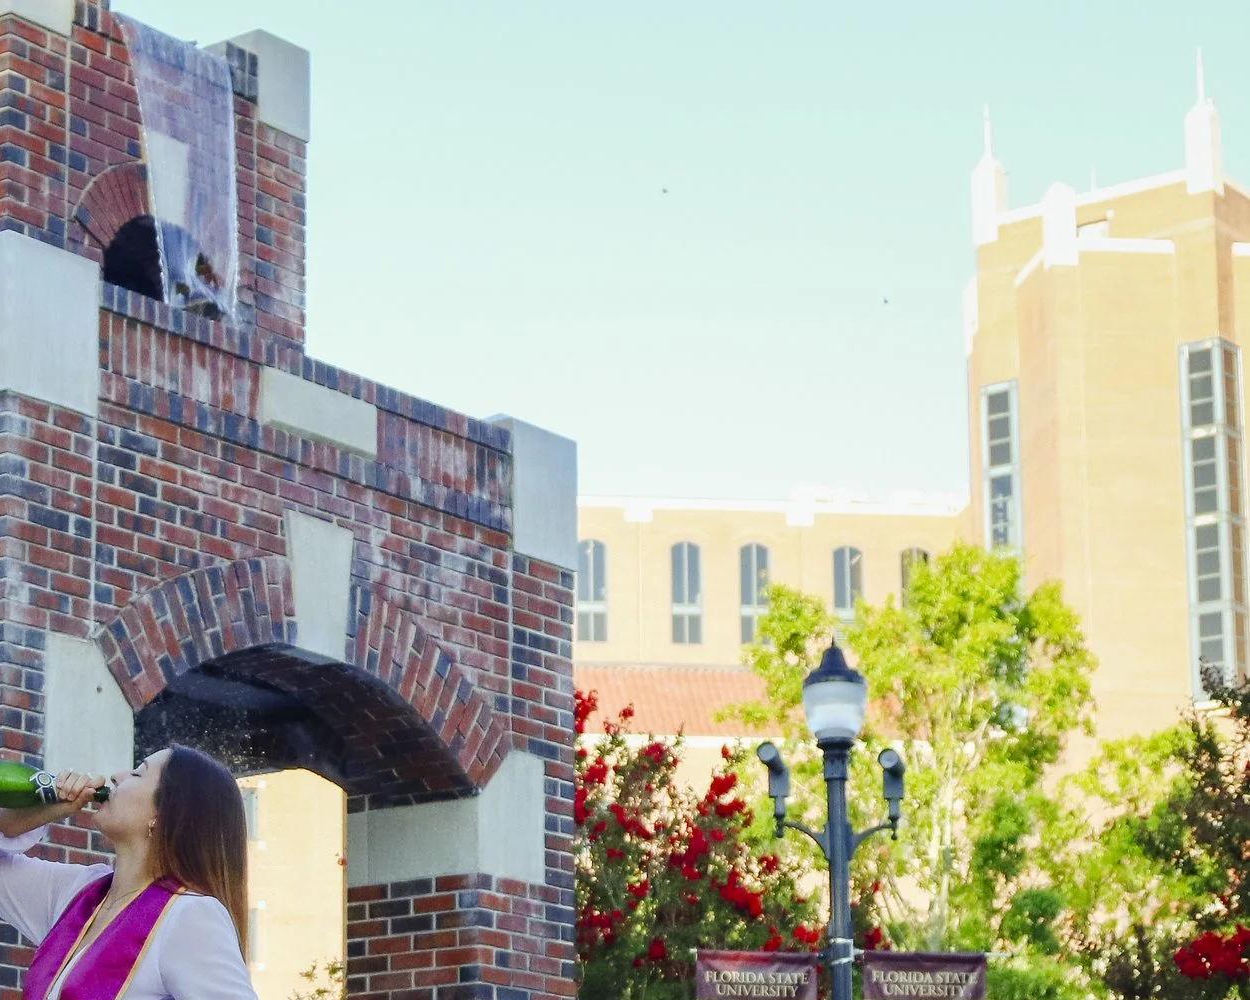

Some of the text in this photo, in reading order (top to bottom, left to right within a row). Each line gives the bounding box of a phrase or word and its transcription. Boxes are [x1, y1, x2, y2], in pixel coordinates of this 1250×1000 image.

[704, 970, 810, 985] FLORIDA STATE
[871, 970, 978, 985] FLORIDA STATE
[715, 984, 799, 998] UNIVERSITY
[882, 983, 967, 998] UNIVERSITY
